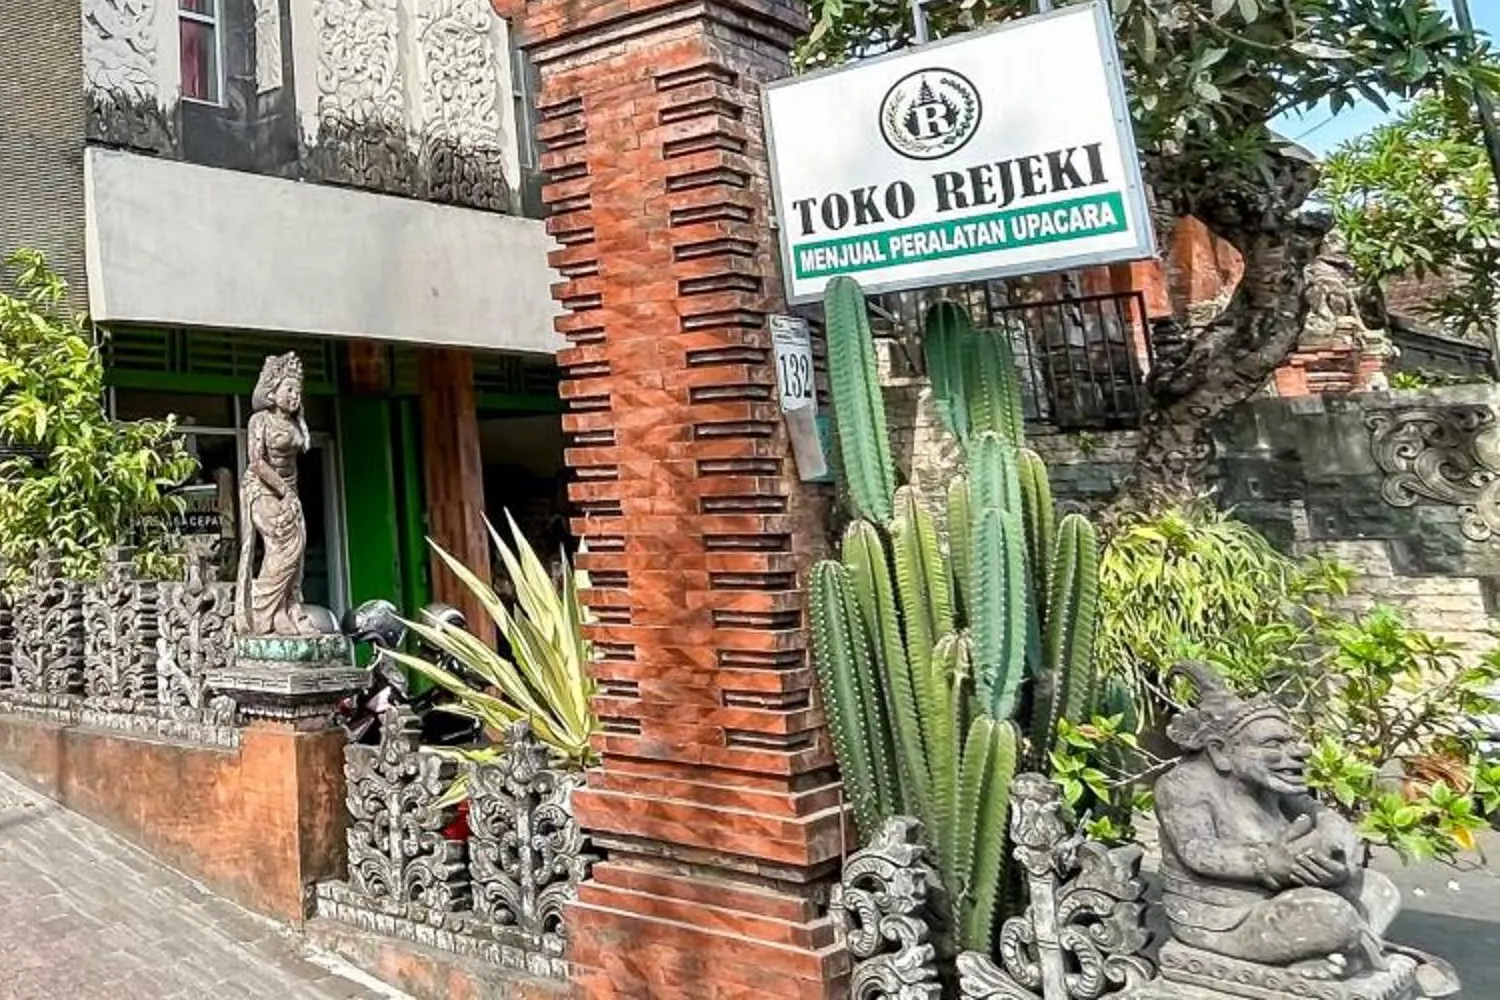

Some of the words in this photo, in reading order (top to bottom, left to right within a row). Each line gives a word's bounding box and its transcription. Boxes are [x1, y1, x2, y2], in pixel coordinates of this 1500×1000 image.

[792, 181, 916, 237] TOKO
[931, 142, 1109, 212] REJEKI
[800, 240, 886, 273] MENJUAL
[889, 219, 1007, 260] PERALATAN
[1011, 201, 1117, 240] UPACARA
[780, 353, 812, 399] 132
